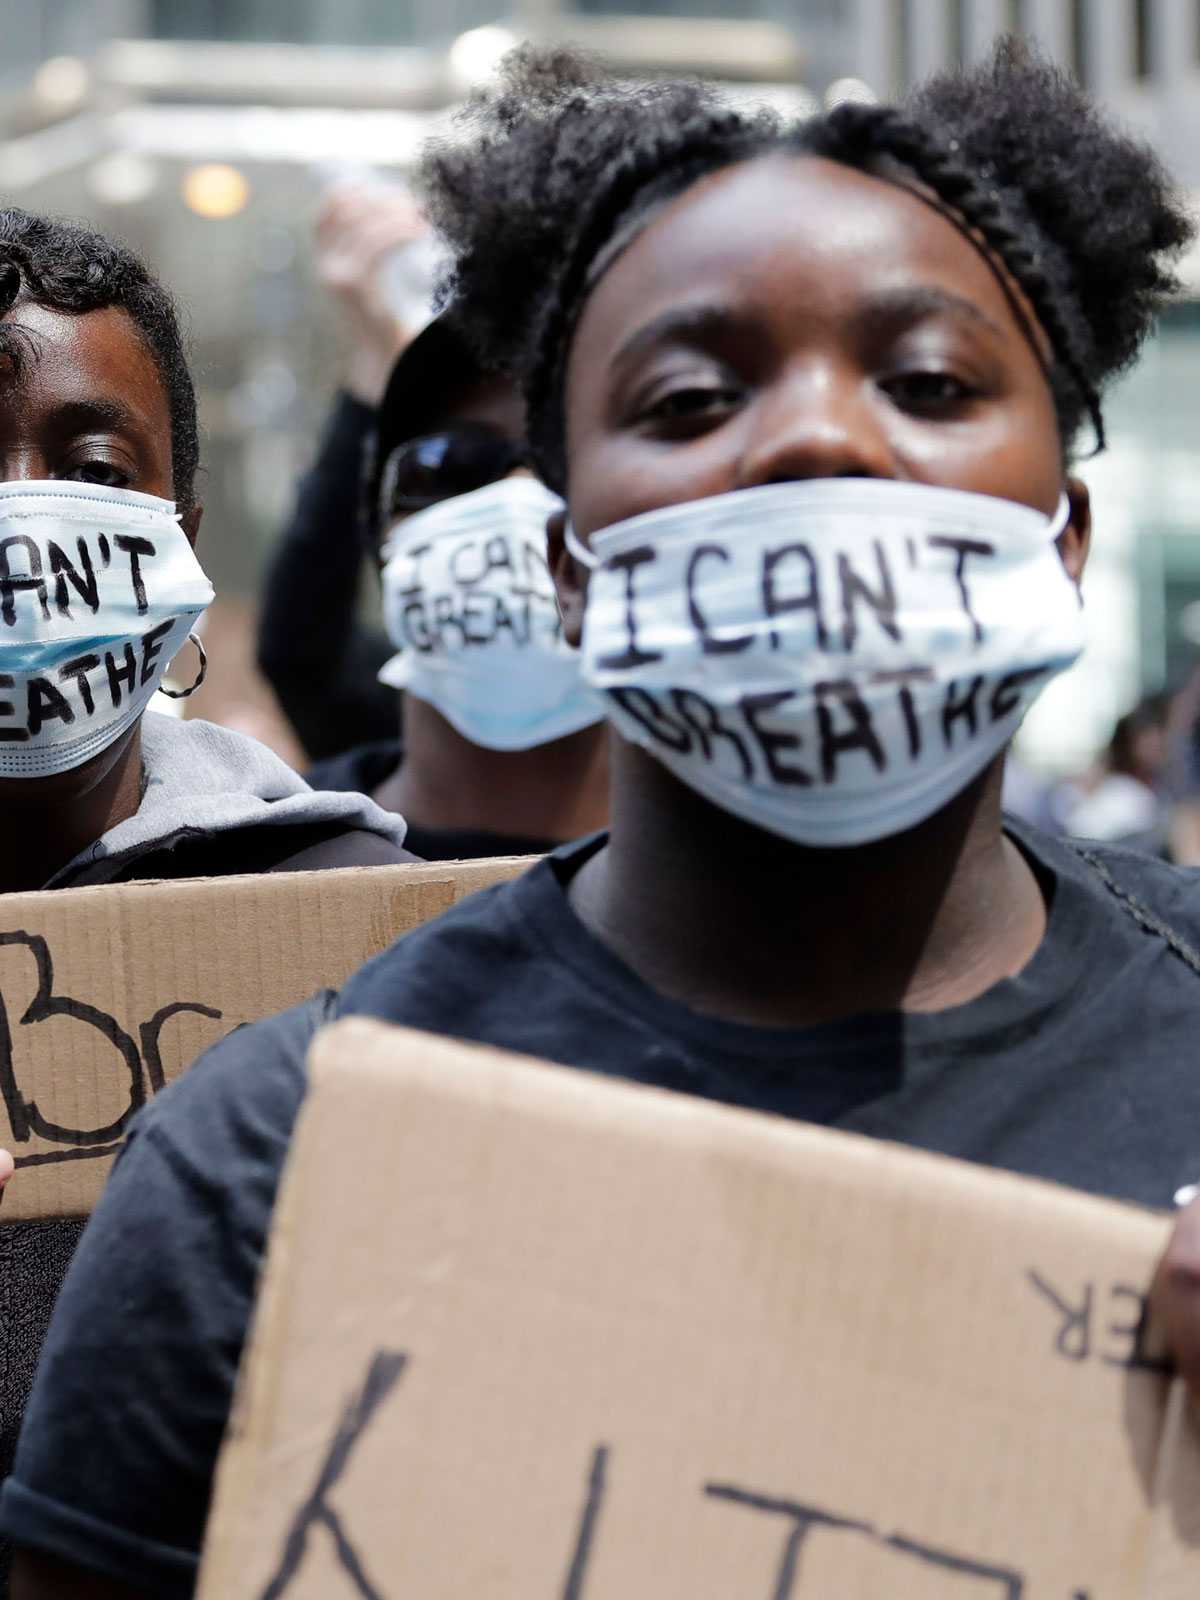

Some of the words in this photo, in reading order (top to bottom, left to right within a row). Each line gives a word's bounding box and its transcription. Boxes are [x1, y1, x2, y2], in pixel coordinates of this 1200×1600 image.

[397, 540, 434, 596] I
[595, 545, 664, 669] I
[686, 534, 995, 654] CAN'T
[606, 662, 1053, 787] BREATHE
